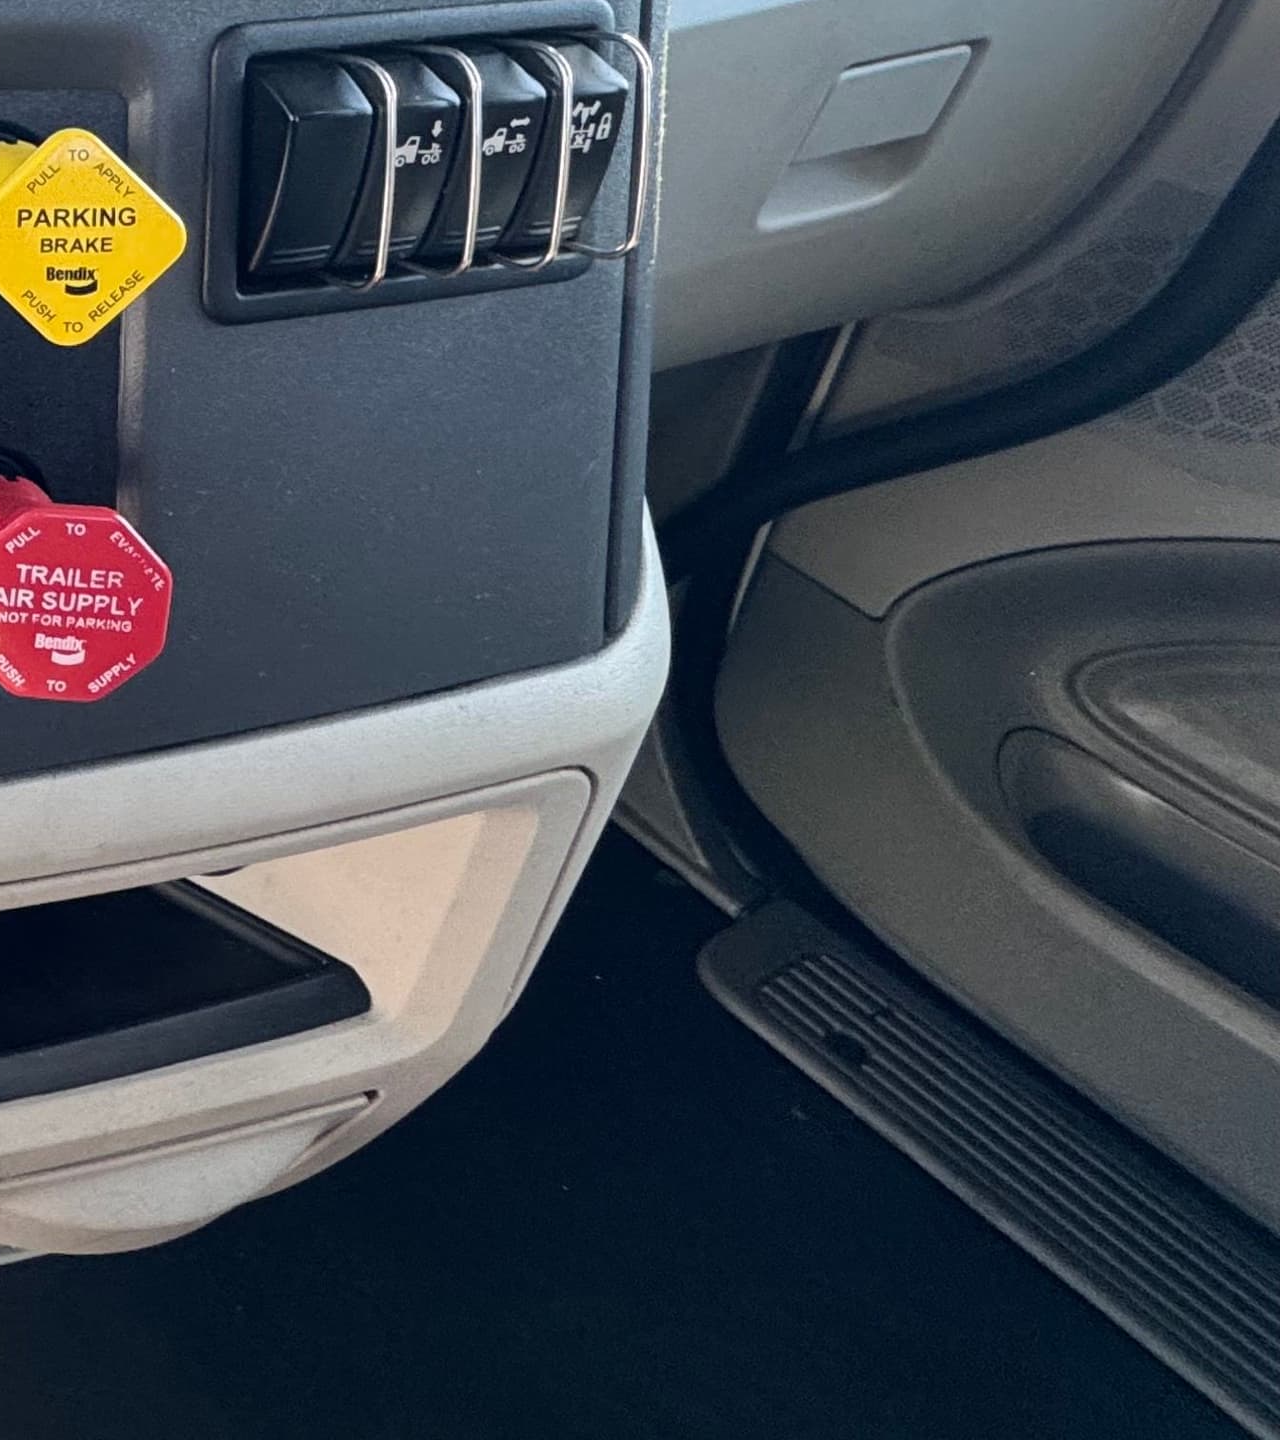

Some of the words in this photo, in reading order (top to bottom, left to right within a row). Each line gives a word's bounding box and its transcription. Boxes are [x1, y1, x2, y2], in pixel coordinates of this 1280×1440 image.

[26, 163, 62, 195] PULL
[68, 148, 90, 162] TO
[93, 162, 136, 200] APPLY
[17, 207, 137, 229] PARKING
[40, 237, 114, 254] BRAKE
[46, 266, 97, 282] Bendix
[21, 289, 58, 324] PUSH
[63, 321, 84, 334] TO
[87, 269, 146, 324] RELEASE
[5, 526, 41, 554] PULL
[65, 522, 87, 537] TO
[16, 563, 125, 590] TRAILER
[41, 591, 144, 617] SUPPLY
[32, 613, 62, 627] FOR
[66, 616, 133, 633] PARKING
[34, 633, 84, 651] Bendix
[46, 680, 67, 693] TO
[88, 652, 138, 694] SUPPLY
